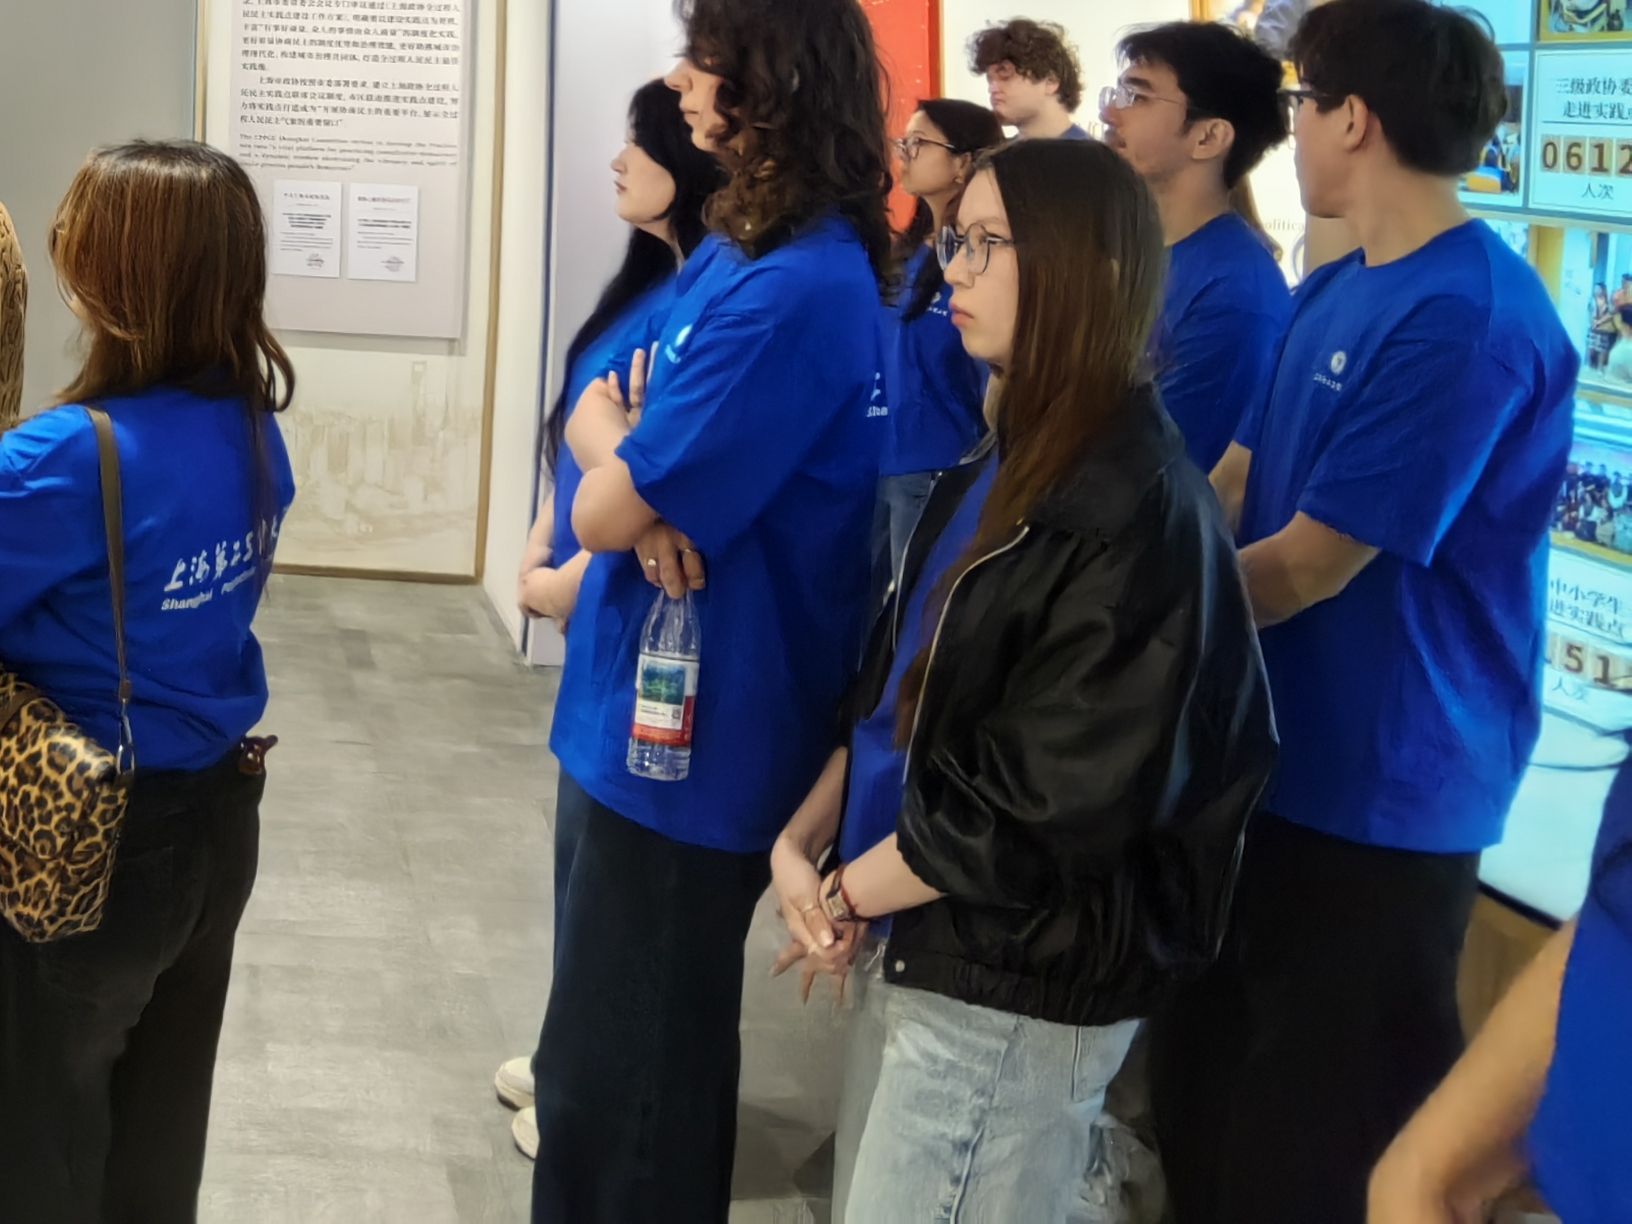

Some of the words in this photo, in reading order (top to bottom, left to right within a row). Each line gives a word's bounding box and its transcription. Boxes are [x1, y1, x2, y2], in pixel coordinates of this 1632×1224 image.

[1563, 100, 1632, 120] 走进实践
[1542, 141, 1632, 174] 0612
[1581, 183, 1614, 200] 人次
